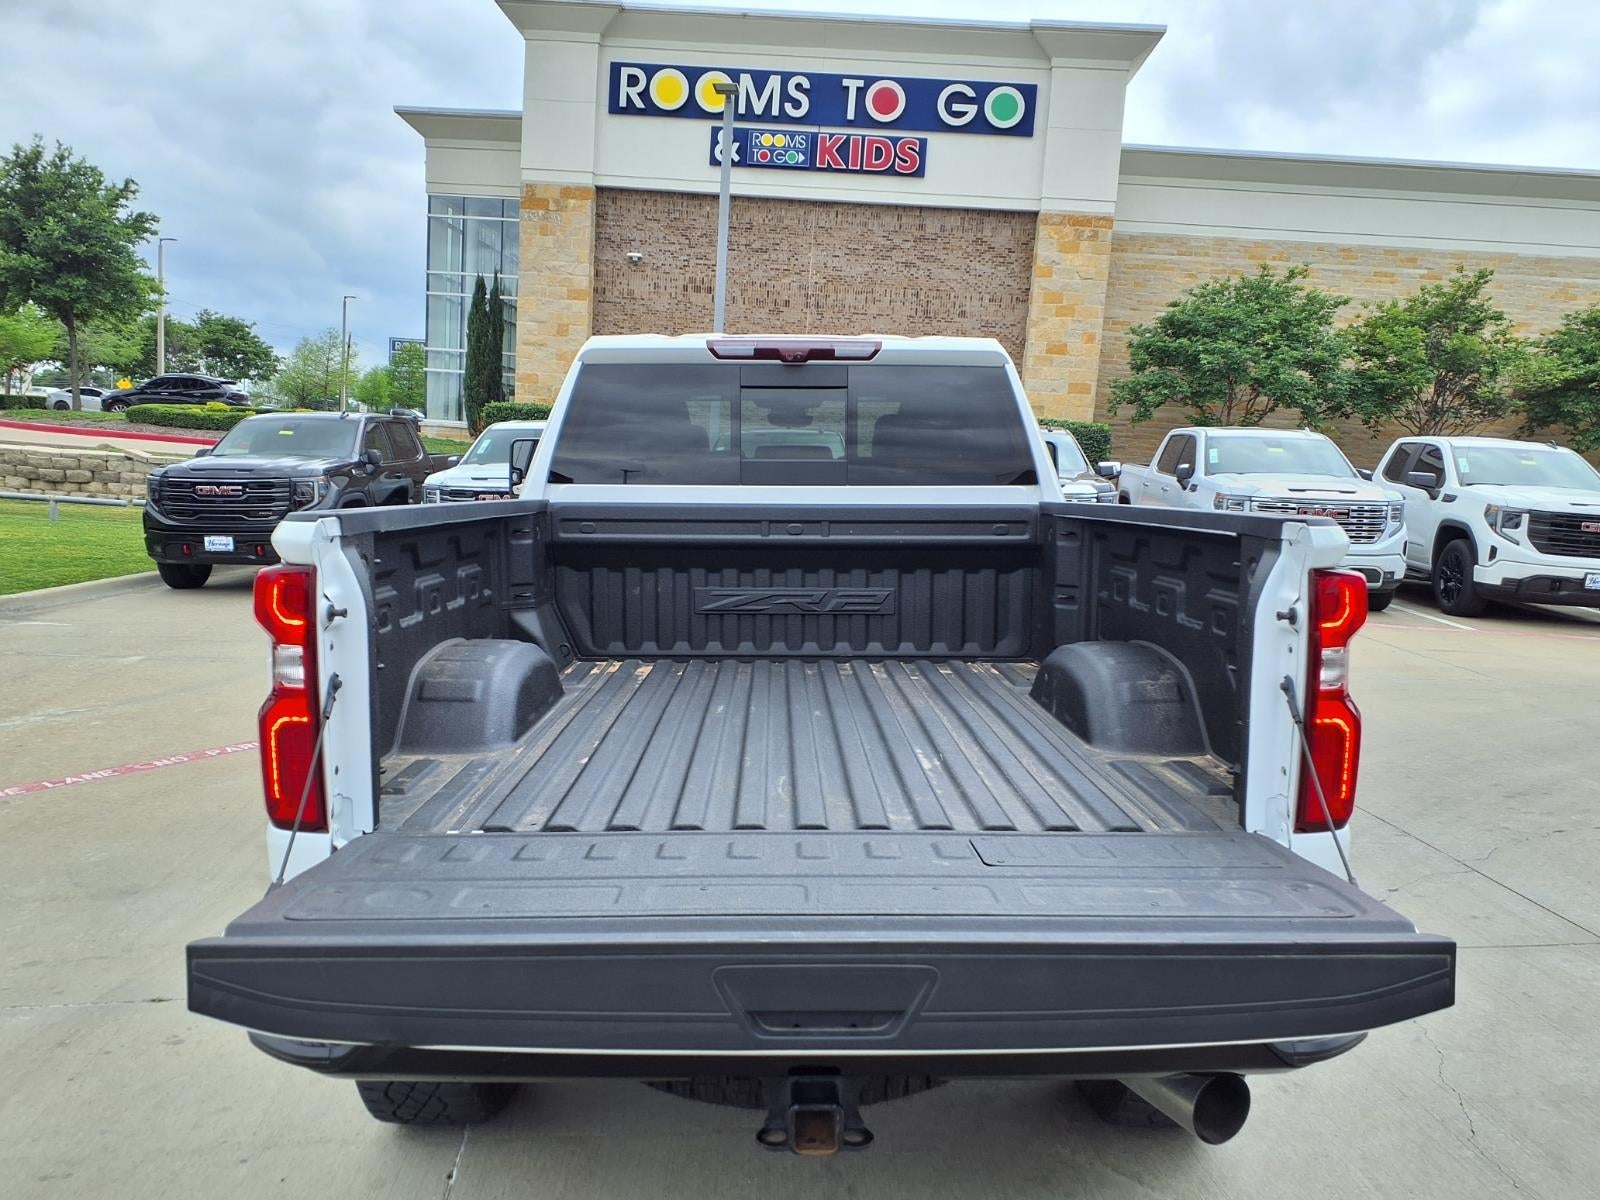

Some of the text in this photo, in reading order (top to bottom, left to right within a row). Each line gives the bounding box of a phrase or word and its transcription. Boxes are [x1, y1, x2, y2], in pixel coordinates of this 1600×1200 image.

[618, 66, 1025, 129] ROOMS TO GO
[752, 132, 806, 149] ROOMS
[752, 148, 799, 164] TO GO
[816, 133, 920, 174] KIDS
[195, 485, 242, 496] GMC
